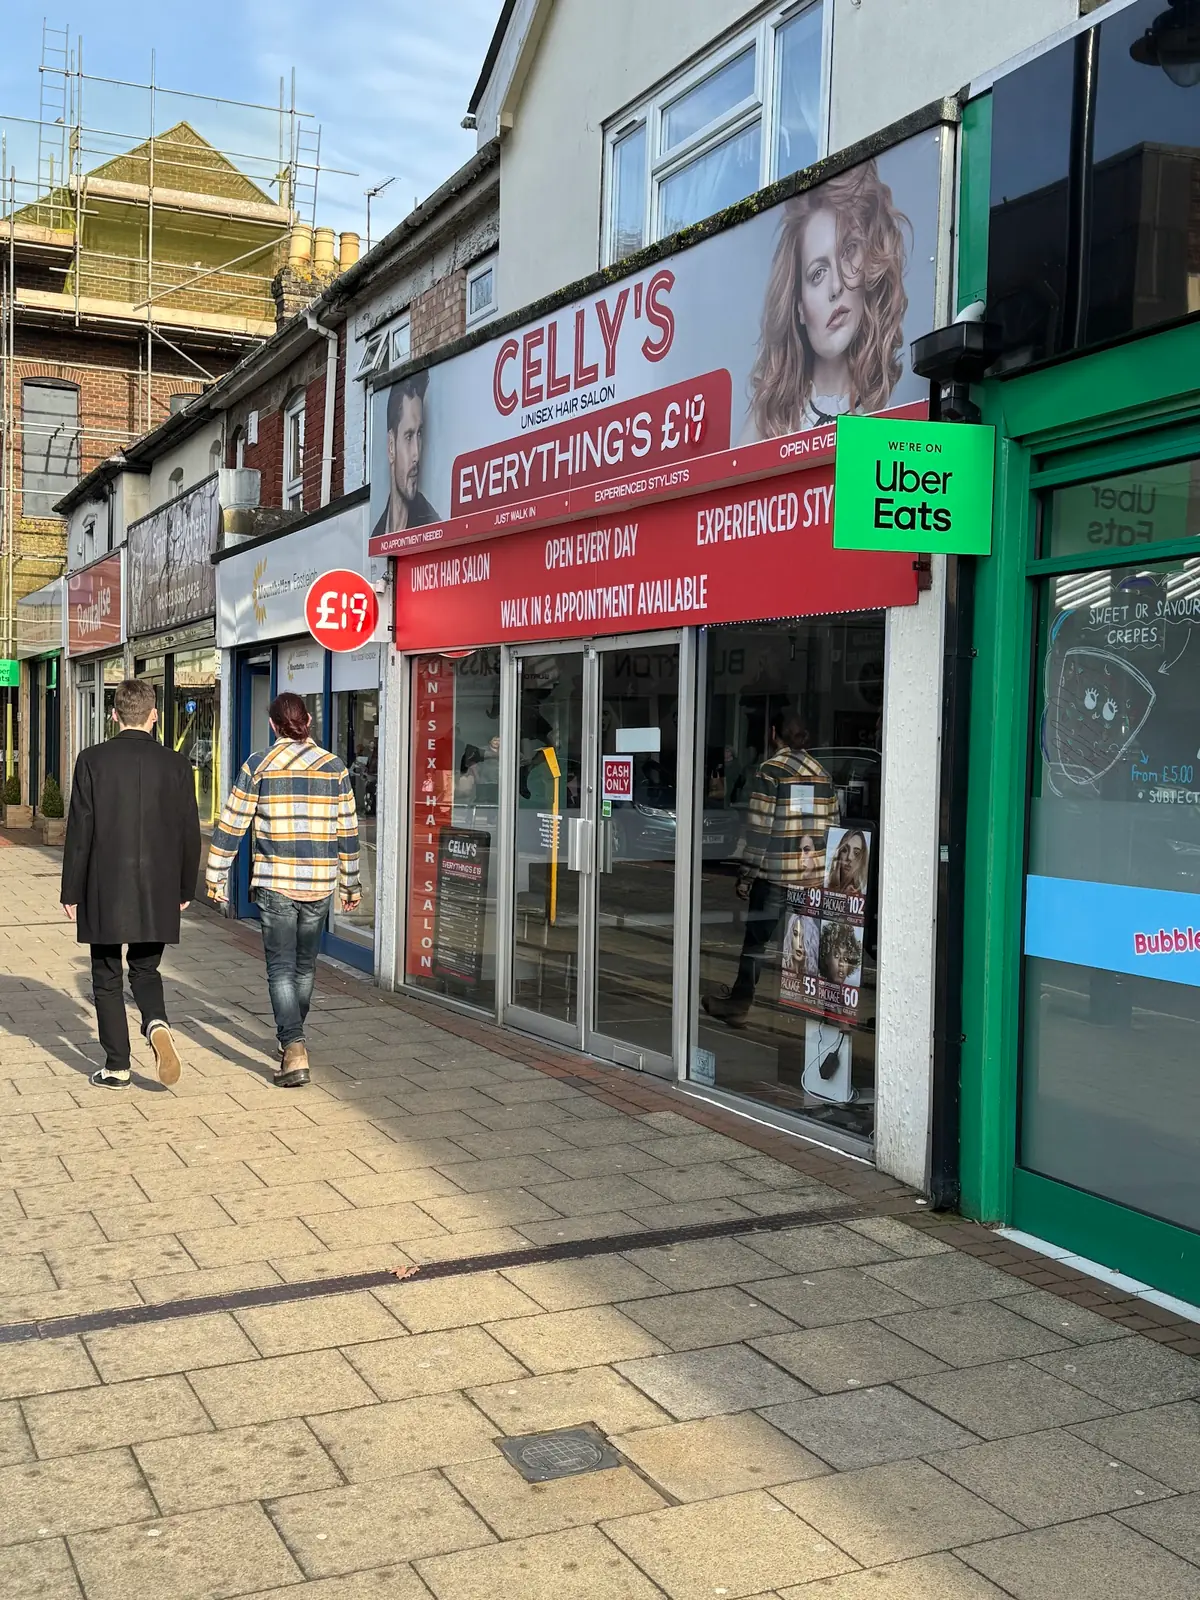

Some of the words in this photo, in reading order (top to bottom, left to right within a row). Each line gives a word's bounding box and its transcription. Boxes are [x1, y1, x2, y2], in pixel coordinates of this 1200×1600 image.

[493, 269, 676, 416] CELLY'S
[521, 404, 553, 429] UNISEX
[555, 397, 579, 418] HAIR
[580, 384, 615, 409] SALON
[459, 411, 652, 504] EVERYTHING'S
[660, 393, 706, 451] £19
[780, 440, 810, 458] OPEN
[812, 432, 836, 450] EVE
[888, 440, 921, 453] WE'RE
[925, 443, 942, 453] ON
[595, 480, 647, 503] EXPERIENCED
[648, 469, 690, 489] STYLISTS
[875, 459, 953, 495] Uber
[494, 513, 510, 525] JUST
[511, 508, 528, 521] WALK
[529, 506, 536, 517] IN
[697, 492, 798, 546] EXPERIENCED
[803, 484, 835, 528] STY
[874, 497, 952, 532] Eats
[381, 541, 389, 551] NO
[388, 533, 422, 549] APPOINTMENT
[422, 529, 444, 542] NEEDED
[545, 534, 574, 570] OPEN
[576, 528, 612, 566] EVERY
[614, 523, 639, 559] DAY
[411, 562, 439, 593] UNISEX
[440, 558, 460, 588] HAIR
[462, 552, 490, 584] SALON
[315, 590, 368, 633] £19
[500, 597, 528, 628] WALK
[530, 595, 541, 625] IN
[543, 594, 552, 624] &
[554, 583, 635, 623] APPOINTMENT
[637, 574, 708, 615] AVAILABLE
[1089, 606, 1129, 625] SWEET
[1135, 603, 1149, 619] OR
[1107, 627, 1158, 645] CREPES
[427, 663, 439, 769] UNISEX
[606, 764, 629, 778] CASH
[1162, 765, 1194, 783] £5.00
[606, 778, 630, 791] ONLY
[1149, 789, 1200, 803] SUBJECT
[425, 795, 437, 864] HAIR
[448, 839, 477, 857] CELLY'S
[807, 887, 821, 908] £99
[823, 897, 846, 913] PACKAGE
[848, 896, 865, 914] £102
[421, 880, 433, 968] SALON
[781, 976, 801, 993] PACKAGE
[803, 975, 816, 996] £55
[818, 987, 840, 1003] PACKAGE
[841, 986, 859, 1008] £60
